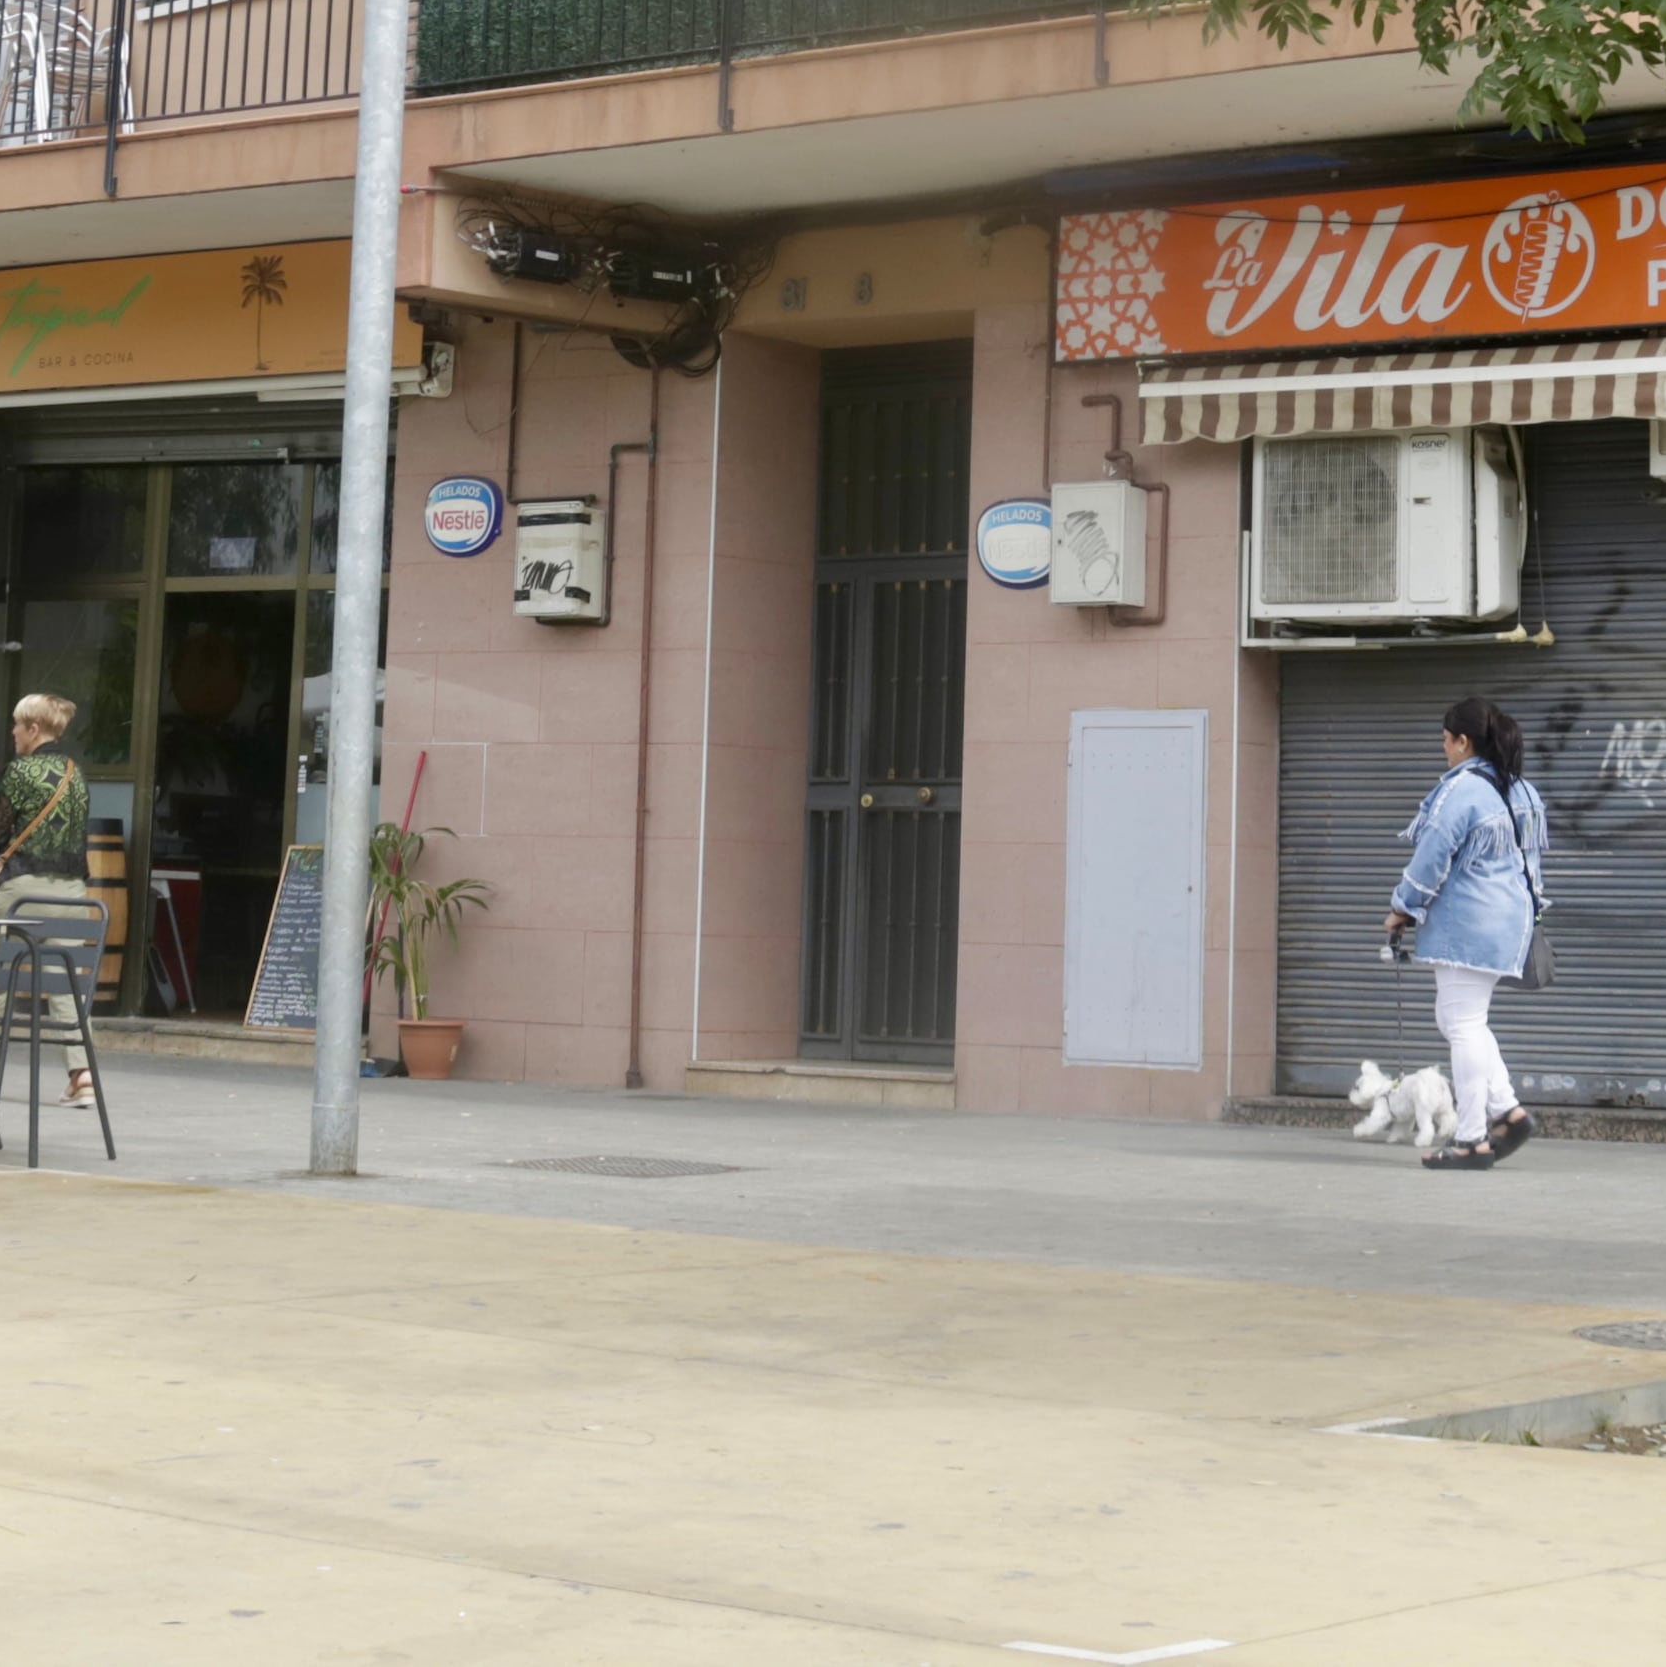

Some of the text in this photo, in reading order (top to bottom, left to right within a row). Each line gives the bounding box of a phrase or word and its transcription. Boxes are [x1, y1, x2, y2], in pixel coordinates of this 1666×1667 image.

[1202, 204, 1472, 338] La Vila
[39, 356, 62, 369] BAR
[84, 352, 133, 366] COCINA
[438, 486, 482, 499] HELADOS
[992, 508, 1043, 523] HELADOS
